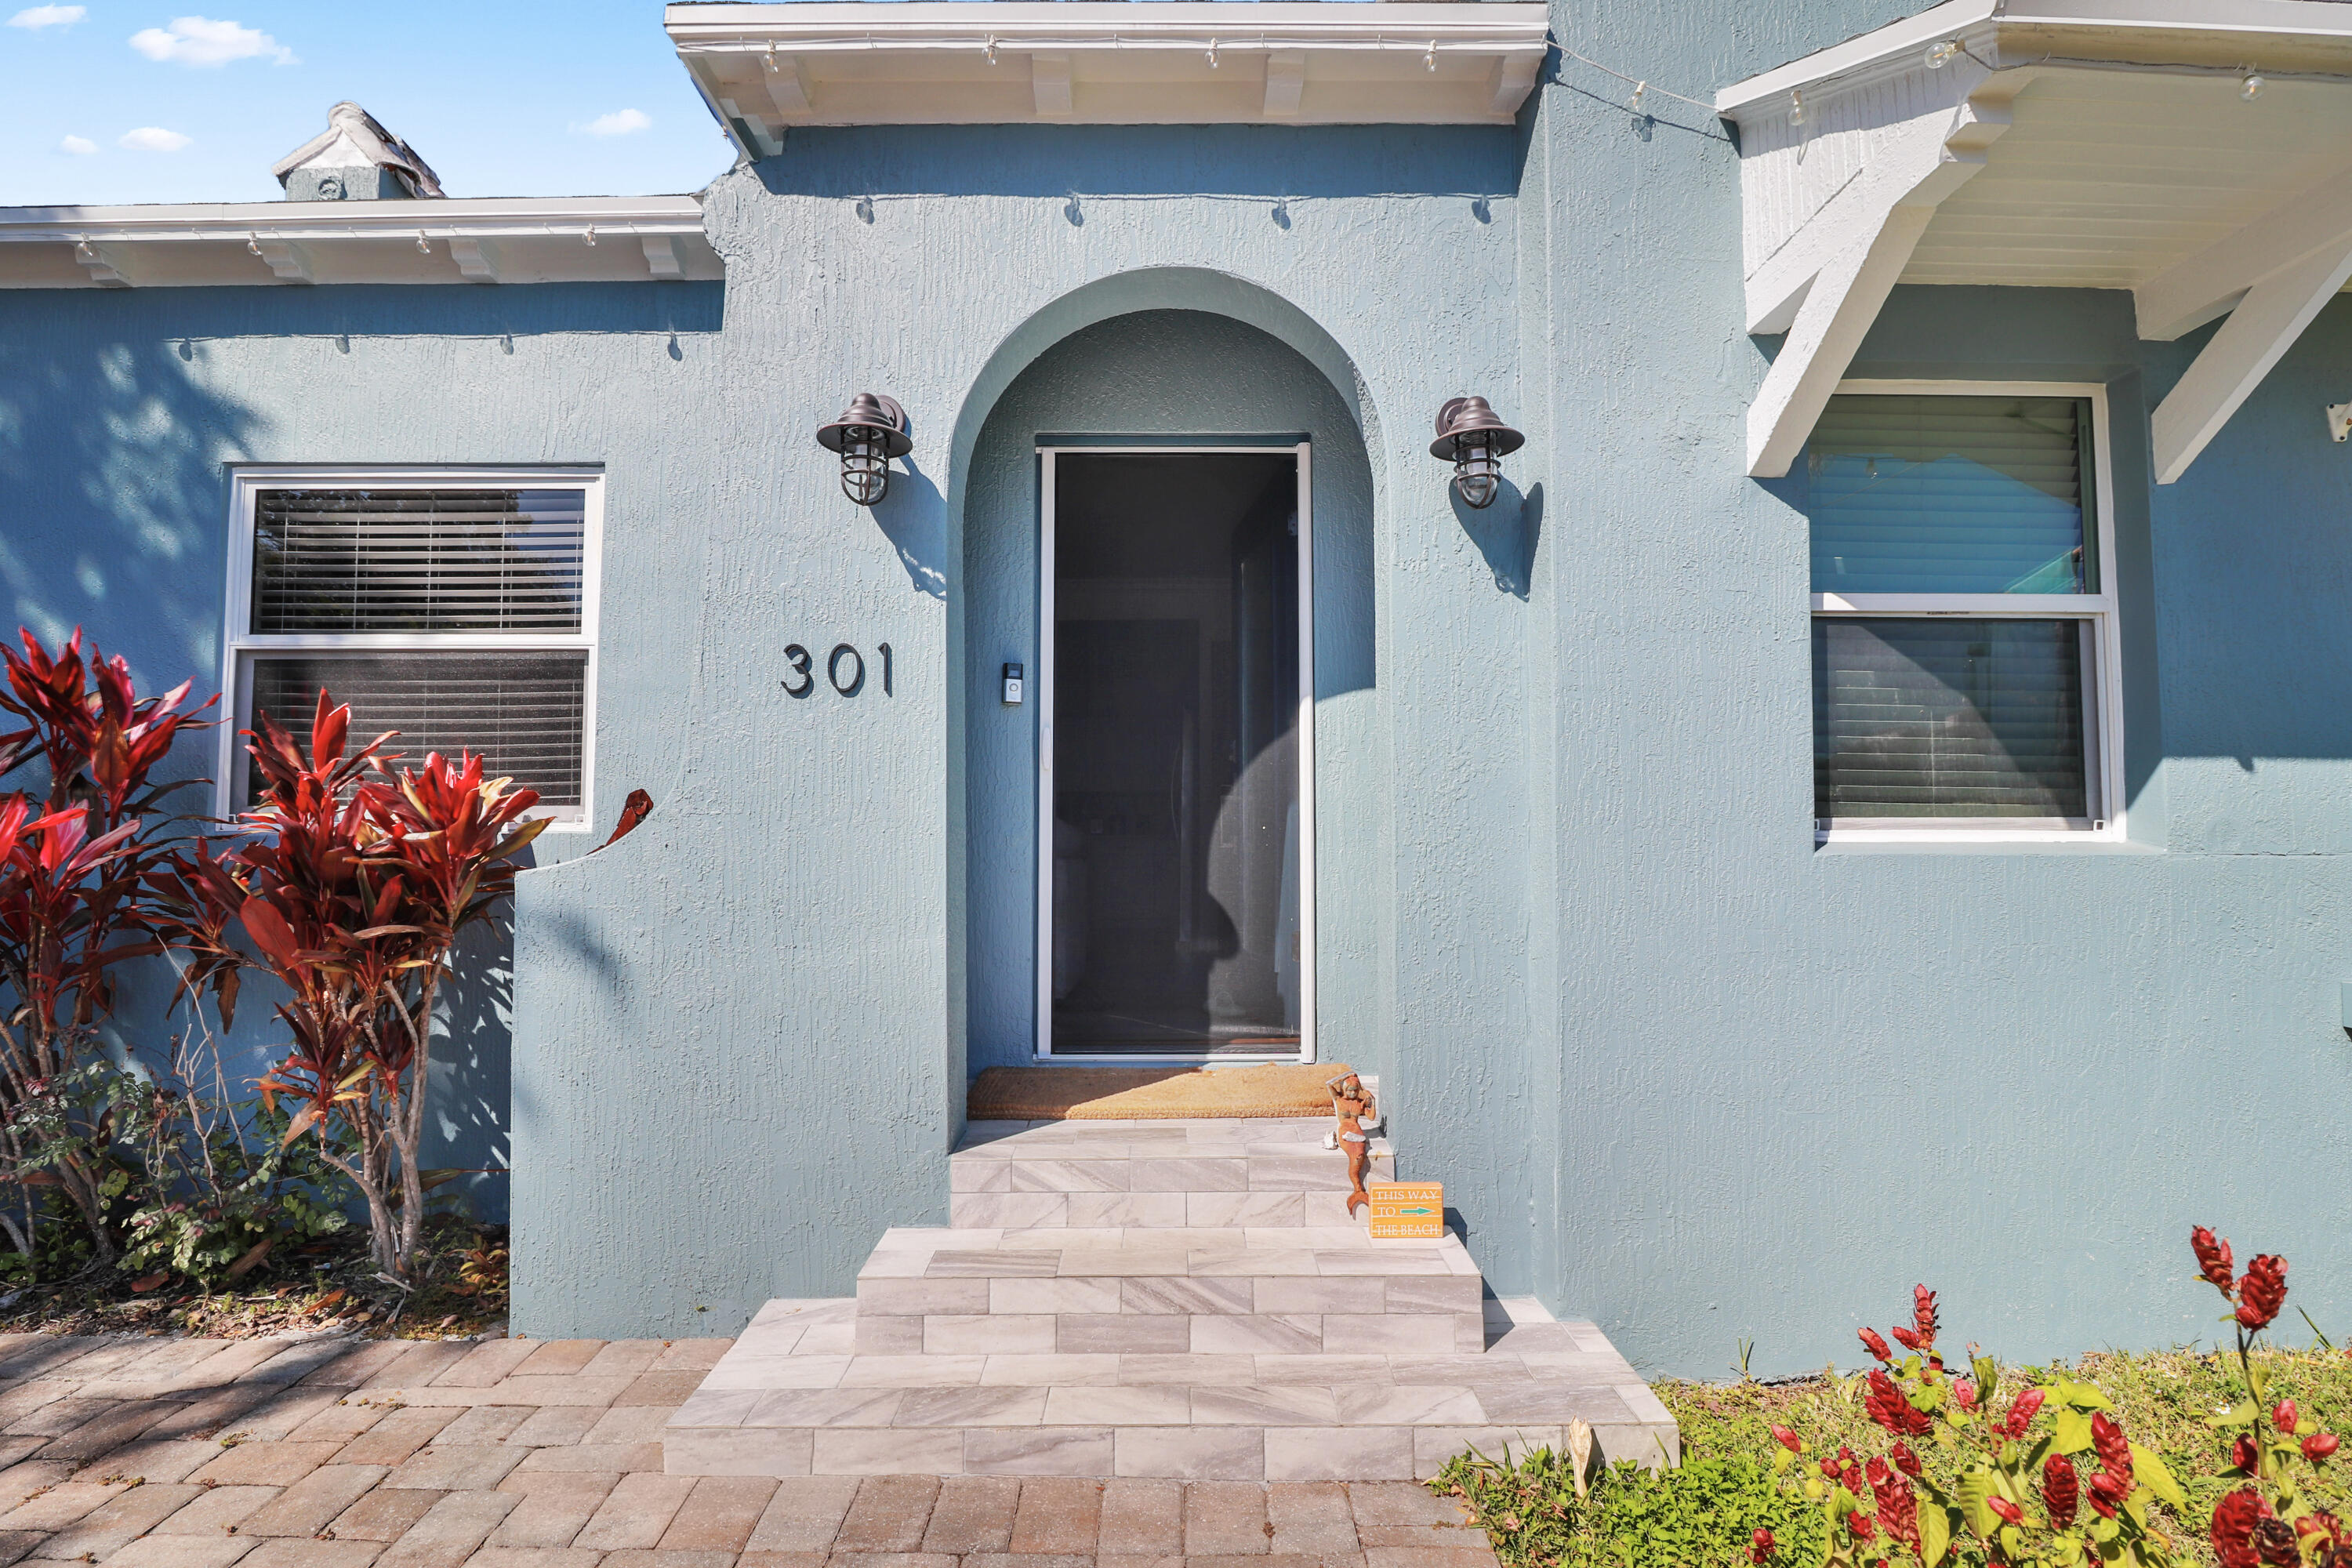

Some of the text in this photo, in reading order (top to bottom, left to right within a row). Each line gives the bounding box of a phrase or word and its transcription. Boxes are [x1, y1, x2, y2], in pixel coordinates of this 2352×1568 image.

[781, 642, 889, 693] 301
[1376, 1190, 1437, 1200] THIS WAY
[1377, 1207, 1396, 1217] TO
[1375, 1224, 1438, 1236] THE BEACH
